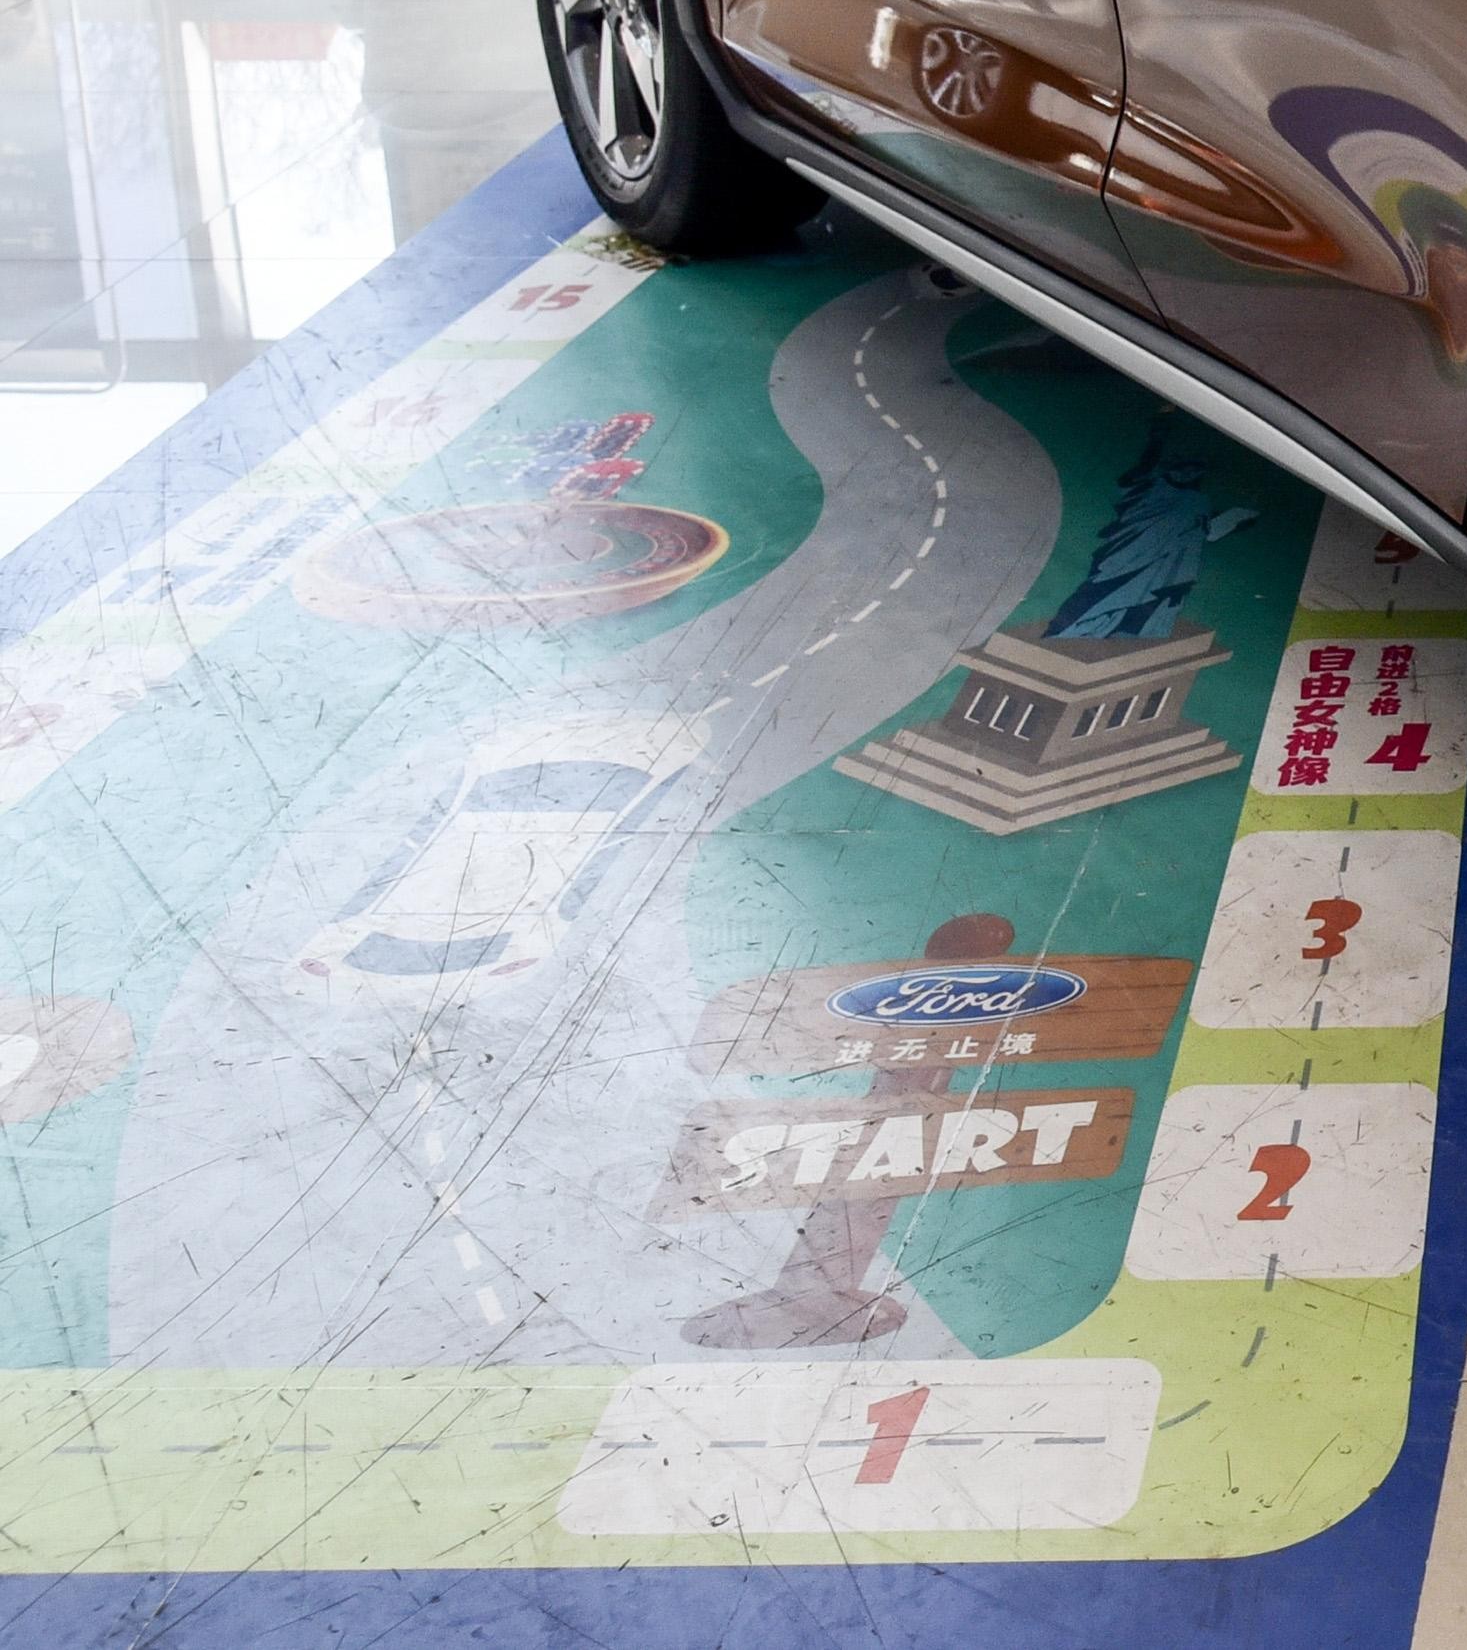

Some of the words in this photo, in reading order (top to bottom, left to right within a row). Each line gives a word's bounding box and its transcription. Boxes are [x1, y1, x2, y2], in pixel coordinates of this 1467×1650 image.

[507, 284, 595, 312] 15
[1367, 644, 1415, 716] 前进2格
[1278, 645, 1355, 787] 自由女神像
[1365, 723, 1432, 771] 4
[1301, 899, 1362, 960] 3
[876, 974, 1036, 1016] Ford
[834, 1032, 1037, 1064] 进无止境
[721, 1101, 1099, 1192] START
[1237, 1144, 1311, 1221] 2
[855, 1387, 930, 1484] 1
